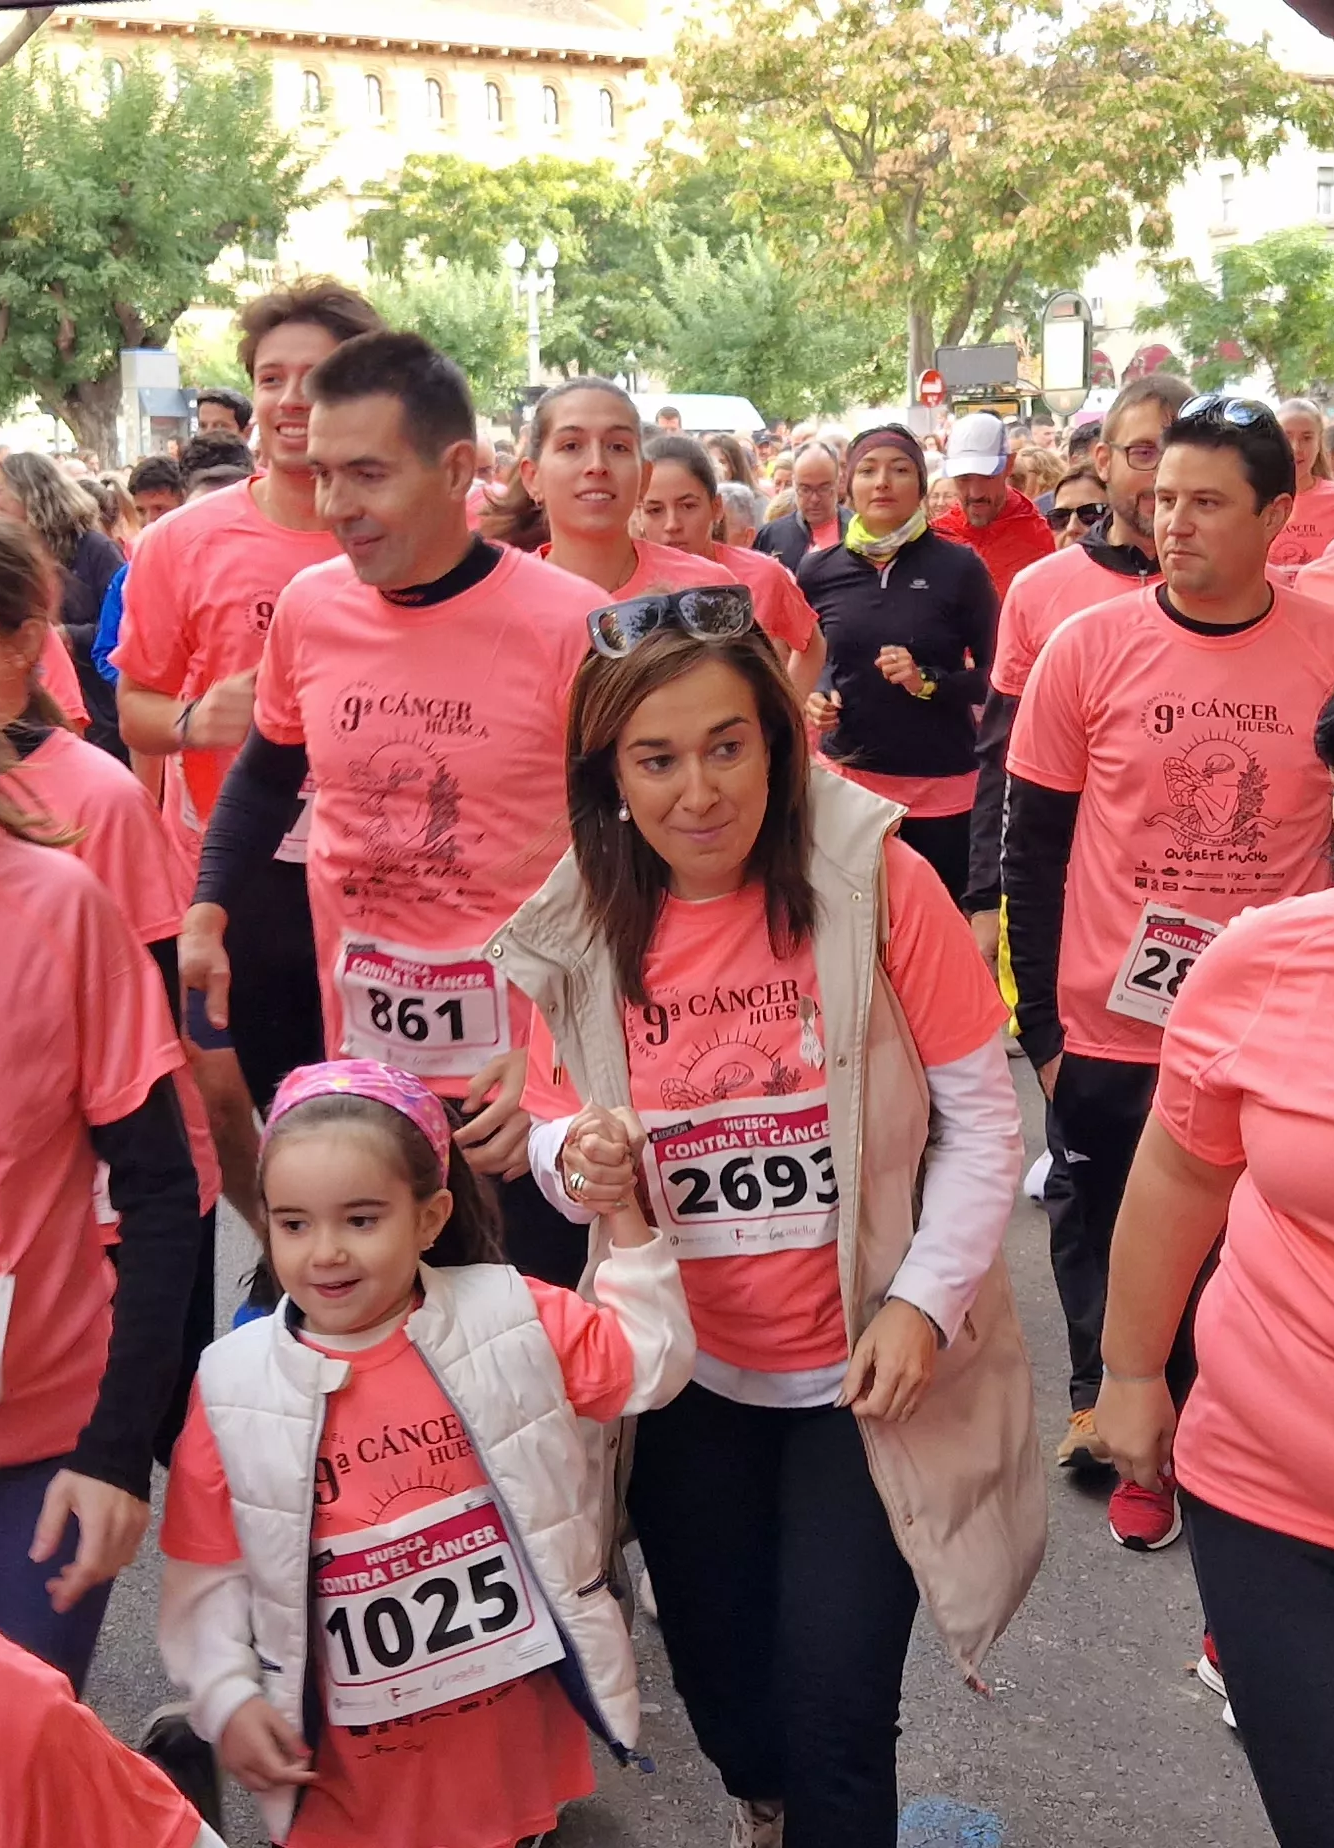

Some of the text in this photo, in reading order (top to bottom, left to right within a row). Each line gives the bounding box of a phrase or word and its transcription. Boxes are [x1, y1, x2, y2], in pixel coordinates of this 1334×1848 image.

[379, 690, 472, 721] CÁNCER
[1154, 698, 1278, 735] 9ª CÁNCER
[1236, 720, 1295, 735] HUESCA
[1164, 846, 1268, 864] QUIÉRETE MUCHO
[351, 956, 402, 986] CONTRA
[422, 973, 487, 990] CÁNCER
[367, 987, 464, 1042] 861
[643, 979, 799, 1047] 9ª CÁNCER
[664, 1120, 832, 1159] CONTRA EL CÁNCE
[723, 1115, 778, 1132] HUESCA
[668, 1146, 839, 1216] 2693
[357, 1414, 467, 1463] CÁNCE
[363, 1534, 428, 1567] HUESCA
[390, 1560, 415, 1580] EL
[417, 1525, 500, 1567] CÁNCER
[325, 1554, 519, 1677] 1025
